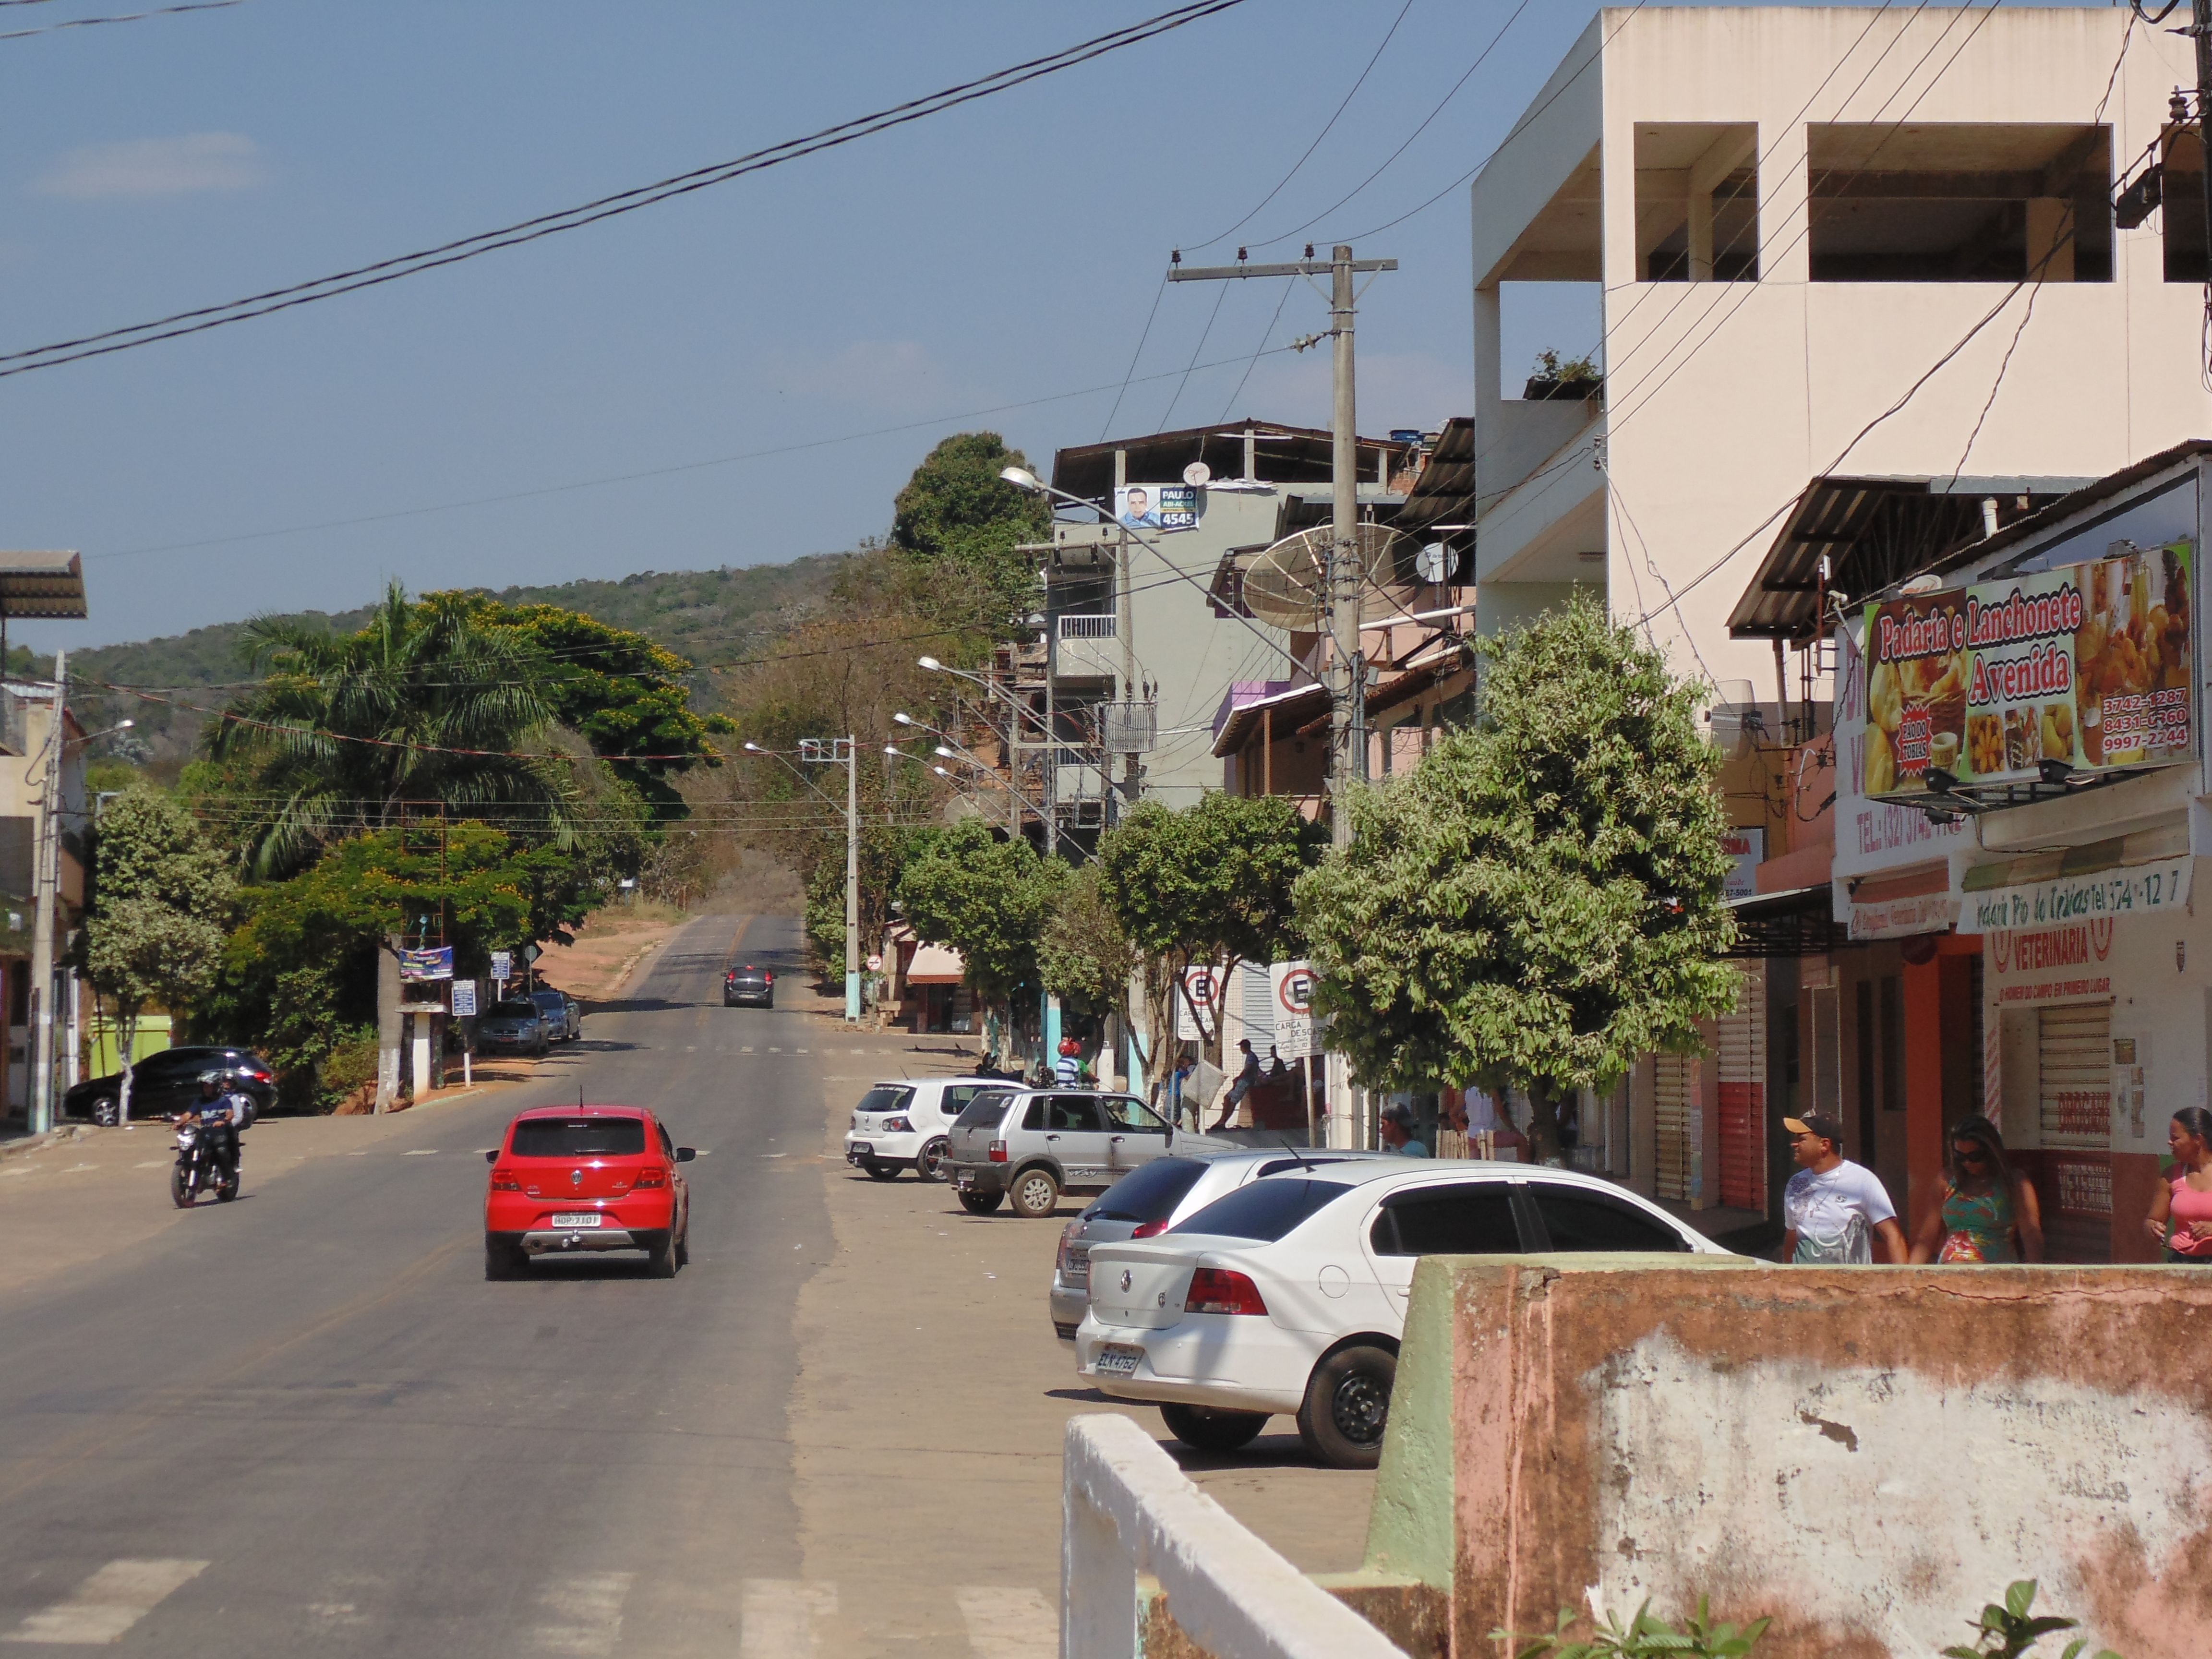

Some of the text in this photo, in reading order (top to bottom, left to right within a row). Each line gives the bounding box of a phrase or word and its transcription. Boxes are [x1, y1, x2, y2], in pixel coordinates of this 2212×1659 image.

[1163, 491, 1194, 500] PAULO
[1163, 513, 1194, 525] 4545
[1880, 586, 2081, 661] Padaria e Lanchonete
[1969, 644, 2070, 704] Avenida
[2104, 687, 2187, 715] 3742-1287
[1903, 718, 1927, 741] PÃO DO
[2104, 726, 2187, 754] 9997-2244
[1903, 740, 1927, 762] TOBIAS
[1275, 1021, 1301, 1031] CARGA
[1069, 1169, 1097, 1178] Way
